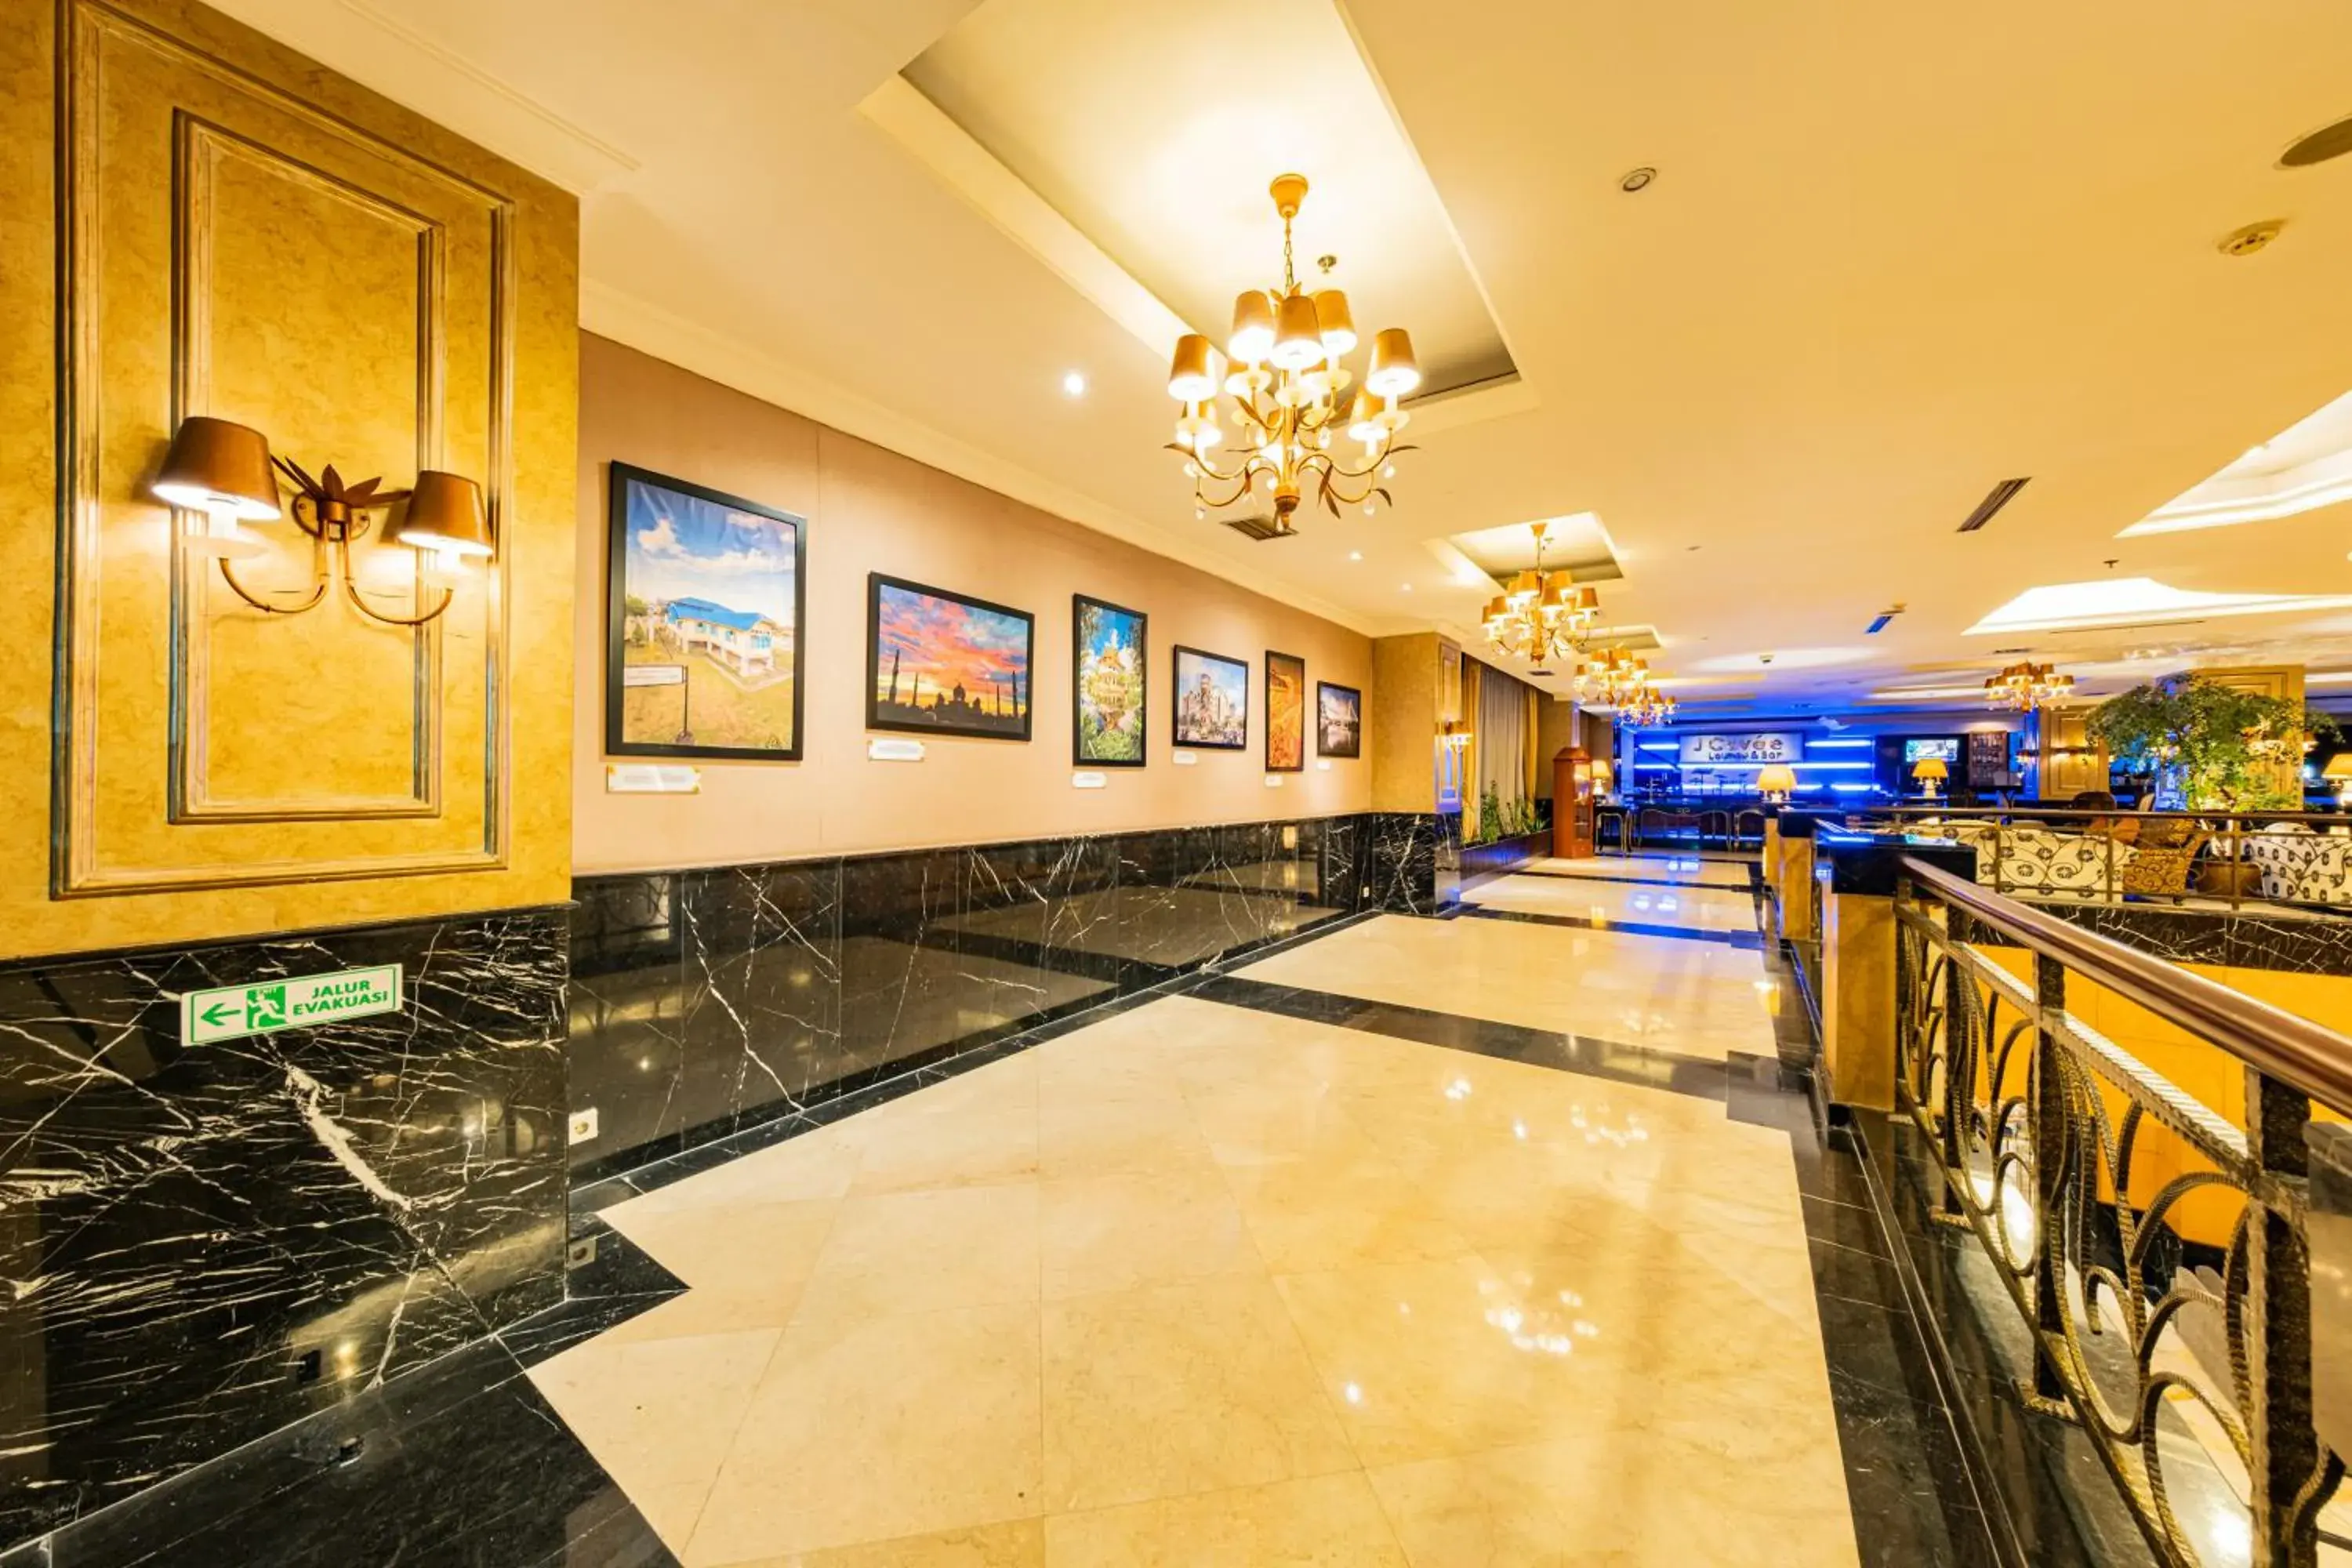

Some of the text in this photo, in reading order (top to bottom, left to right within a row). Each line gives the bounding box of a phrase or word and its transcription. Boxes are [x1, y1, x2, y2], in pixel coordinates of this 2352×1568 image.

[1751, 751, 1759, 760] &
[1762, 751, 1782, 760] Bar
[312, 980, 370, 999] JALUR
[292, 990, 388, 1016] EVAKUASI
